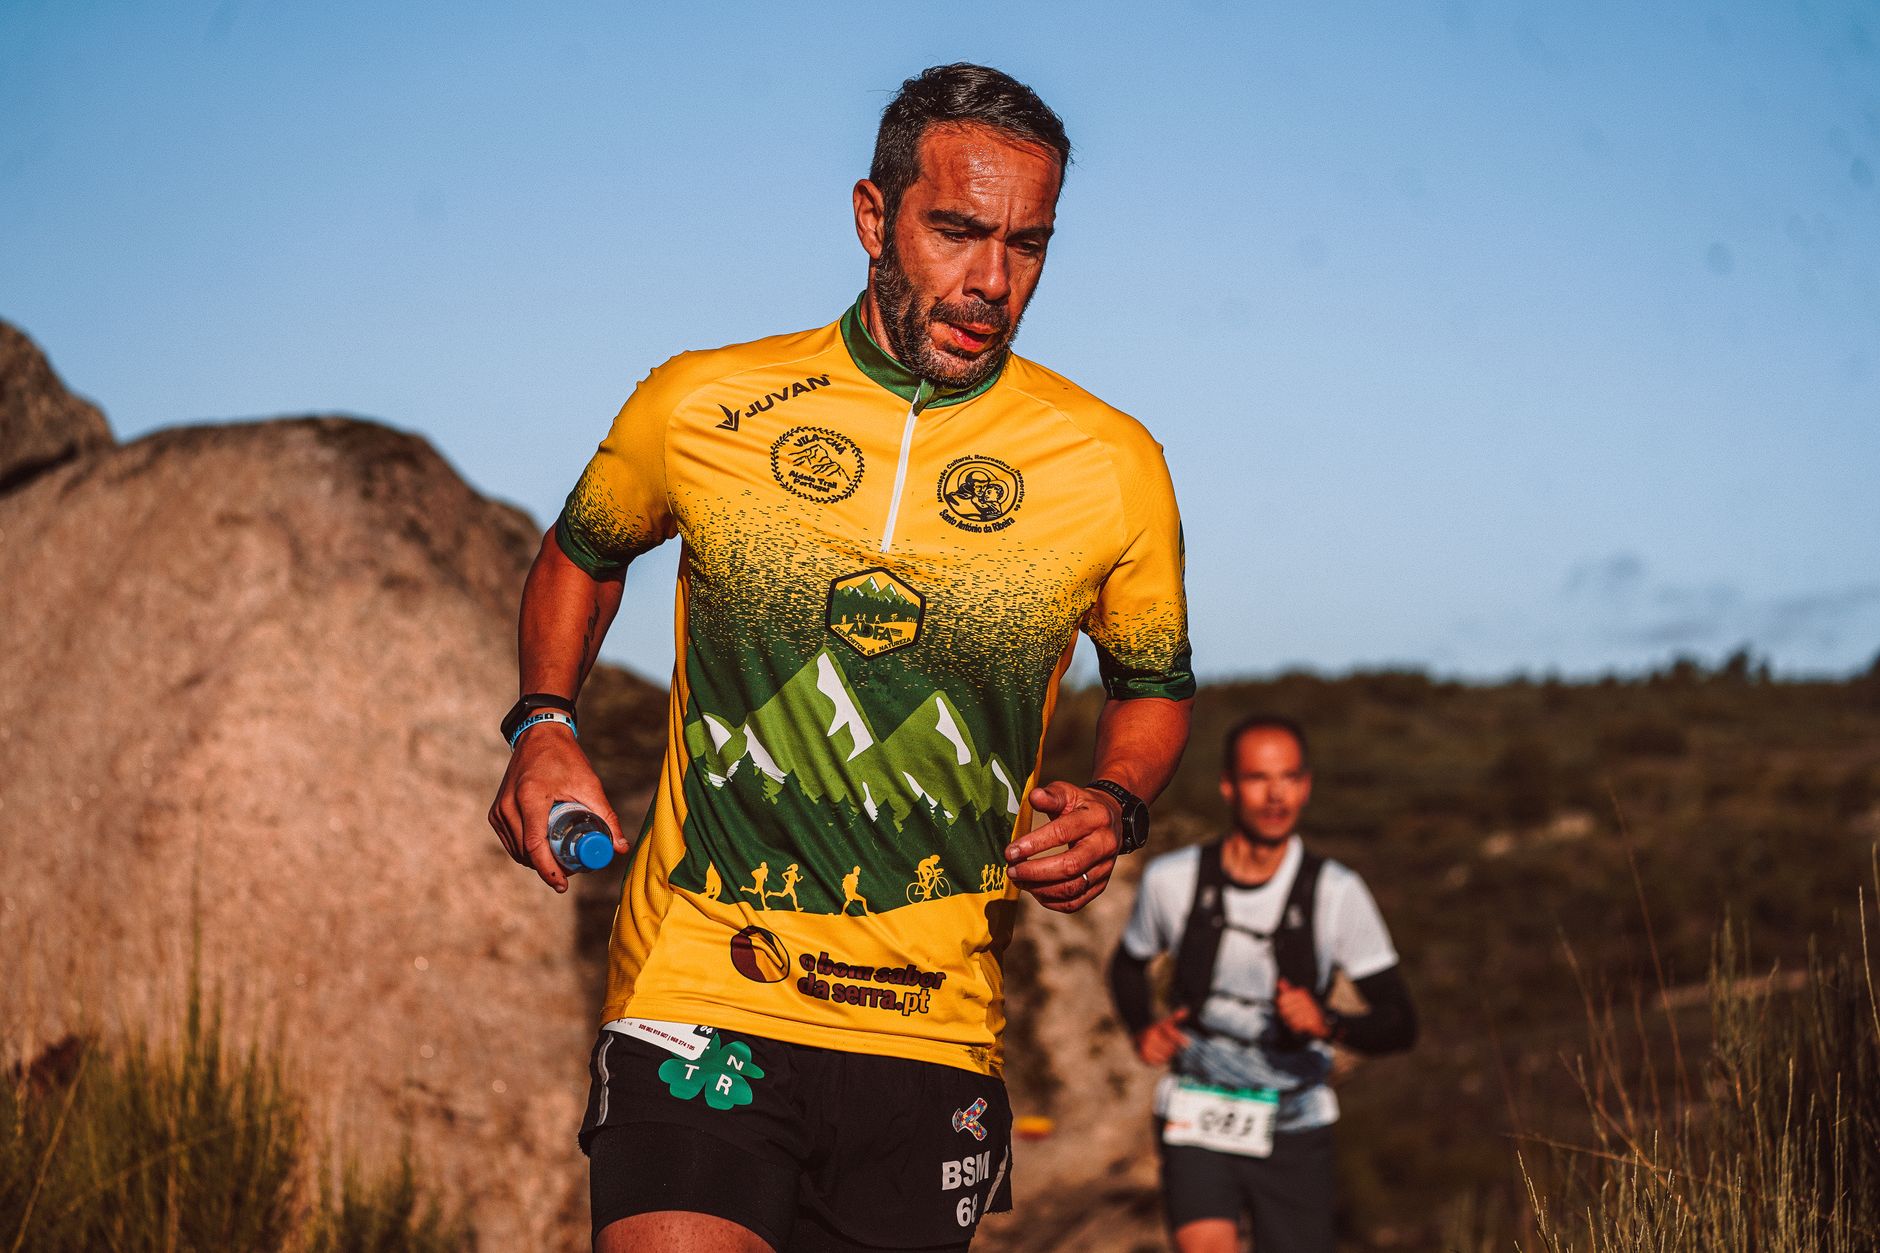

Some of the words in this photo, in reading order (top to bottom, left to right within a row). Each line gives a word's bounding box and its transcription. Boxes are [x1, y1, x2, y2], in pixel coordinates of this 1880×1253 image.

[745, 375, 831, 418] JUVAN
[974, 454, 1011, 469] Recreativa
[793, 478, 830, 493] Portugal
[818, 478, 837, 489] Trail
[939, 509, 957, 525] Santo
[983, 524, 993, 533] da
[799, 953, 817, 972] o
[817, 951, 875, 981] bom
[873, 964, 947, 989] sabor
[797, 972, 830, 1000] da
[832, 983, 930, 1016] serra.pt
[684, 1063, 700, 1080] T
[726, 1054, 745, 1071] N
[715, 1073, 733, 1096] R
[941, 1150, 991, 1191] BSM
